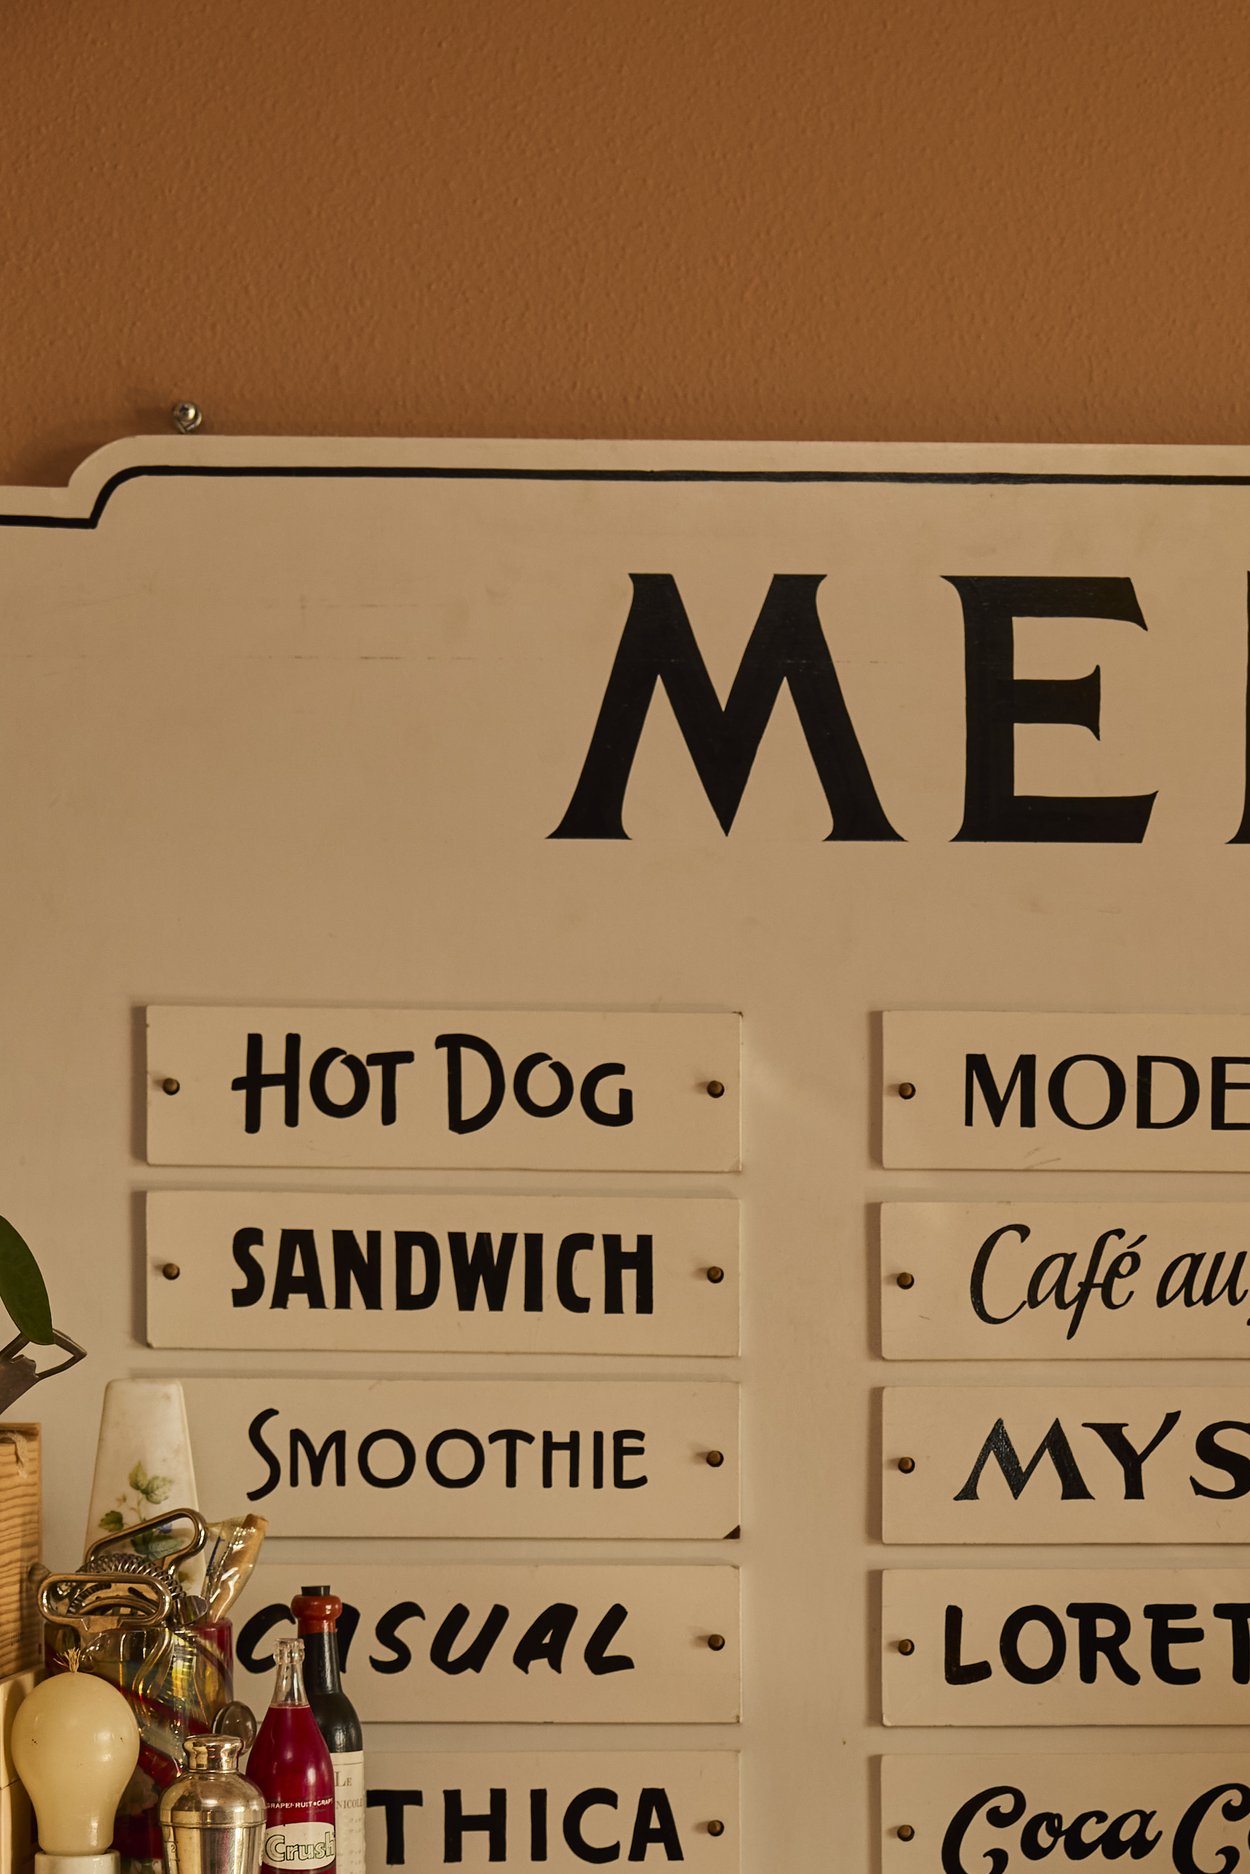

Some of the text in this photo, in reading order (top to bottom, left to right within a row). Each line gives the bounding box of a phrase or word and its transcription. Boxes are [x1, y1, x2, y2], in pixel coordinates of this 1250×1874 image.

[231, 1032, 634, 1135] HOT DOG
[231, 1227, 654, 1315] SANDWICH
[969, 1223, 1148, 1341] Café
[1155, 1249, 1249, 1308] au
[246, 1408, 649, 1501] SMOOTHIE
[265, 1832, 335, 1862] Crush
[366, 1789, 684, 1864] THICA
